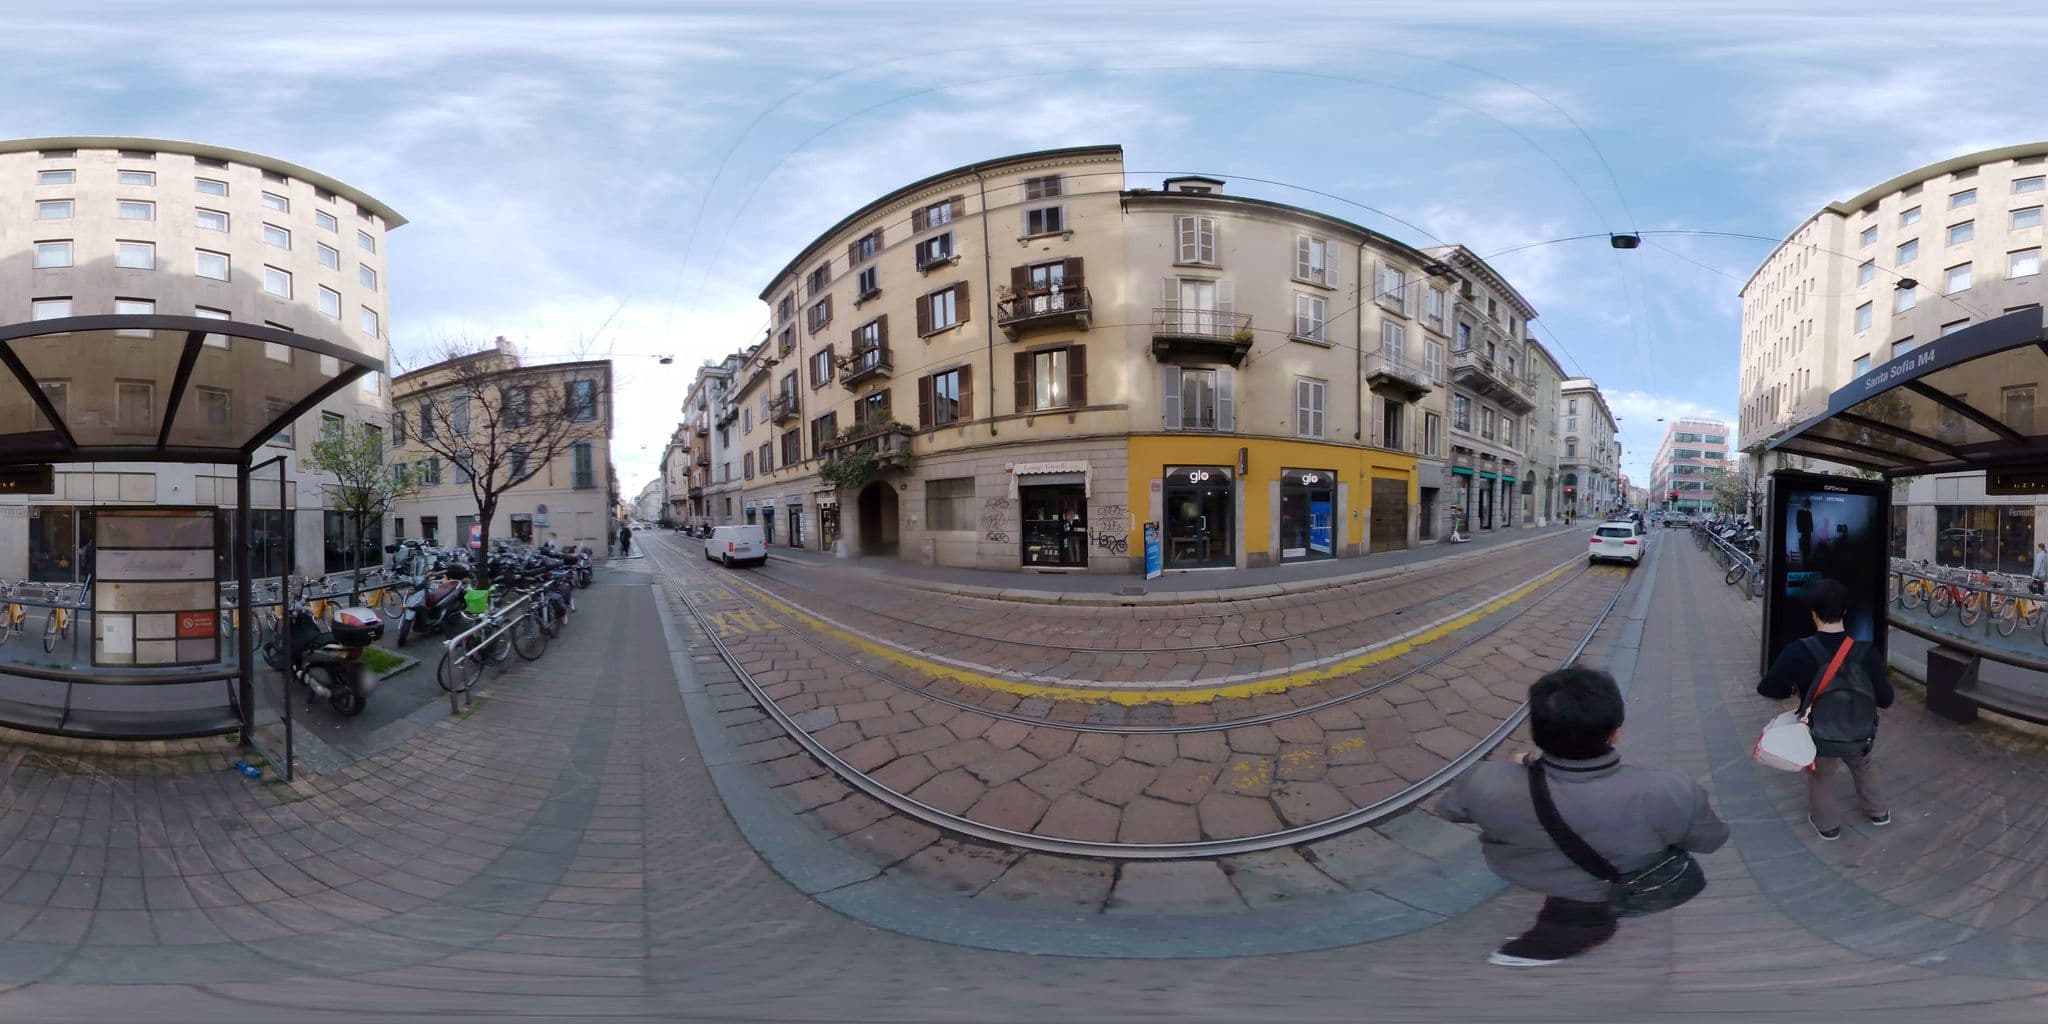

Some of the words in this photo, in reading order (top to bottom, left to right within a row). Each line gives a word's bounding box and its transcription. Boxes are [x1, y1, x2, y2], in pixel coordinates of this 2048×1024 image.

[1865, 371, 1888, 389] Santa
[1890, 360, 1915, 378] Sofia
[1917, 349, 1936, 367] M4
[1189, 470, 1209, 484] glo
[1302, 473, 1318, 485] glo
